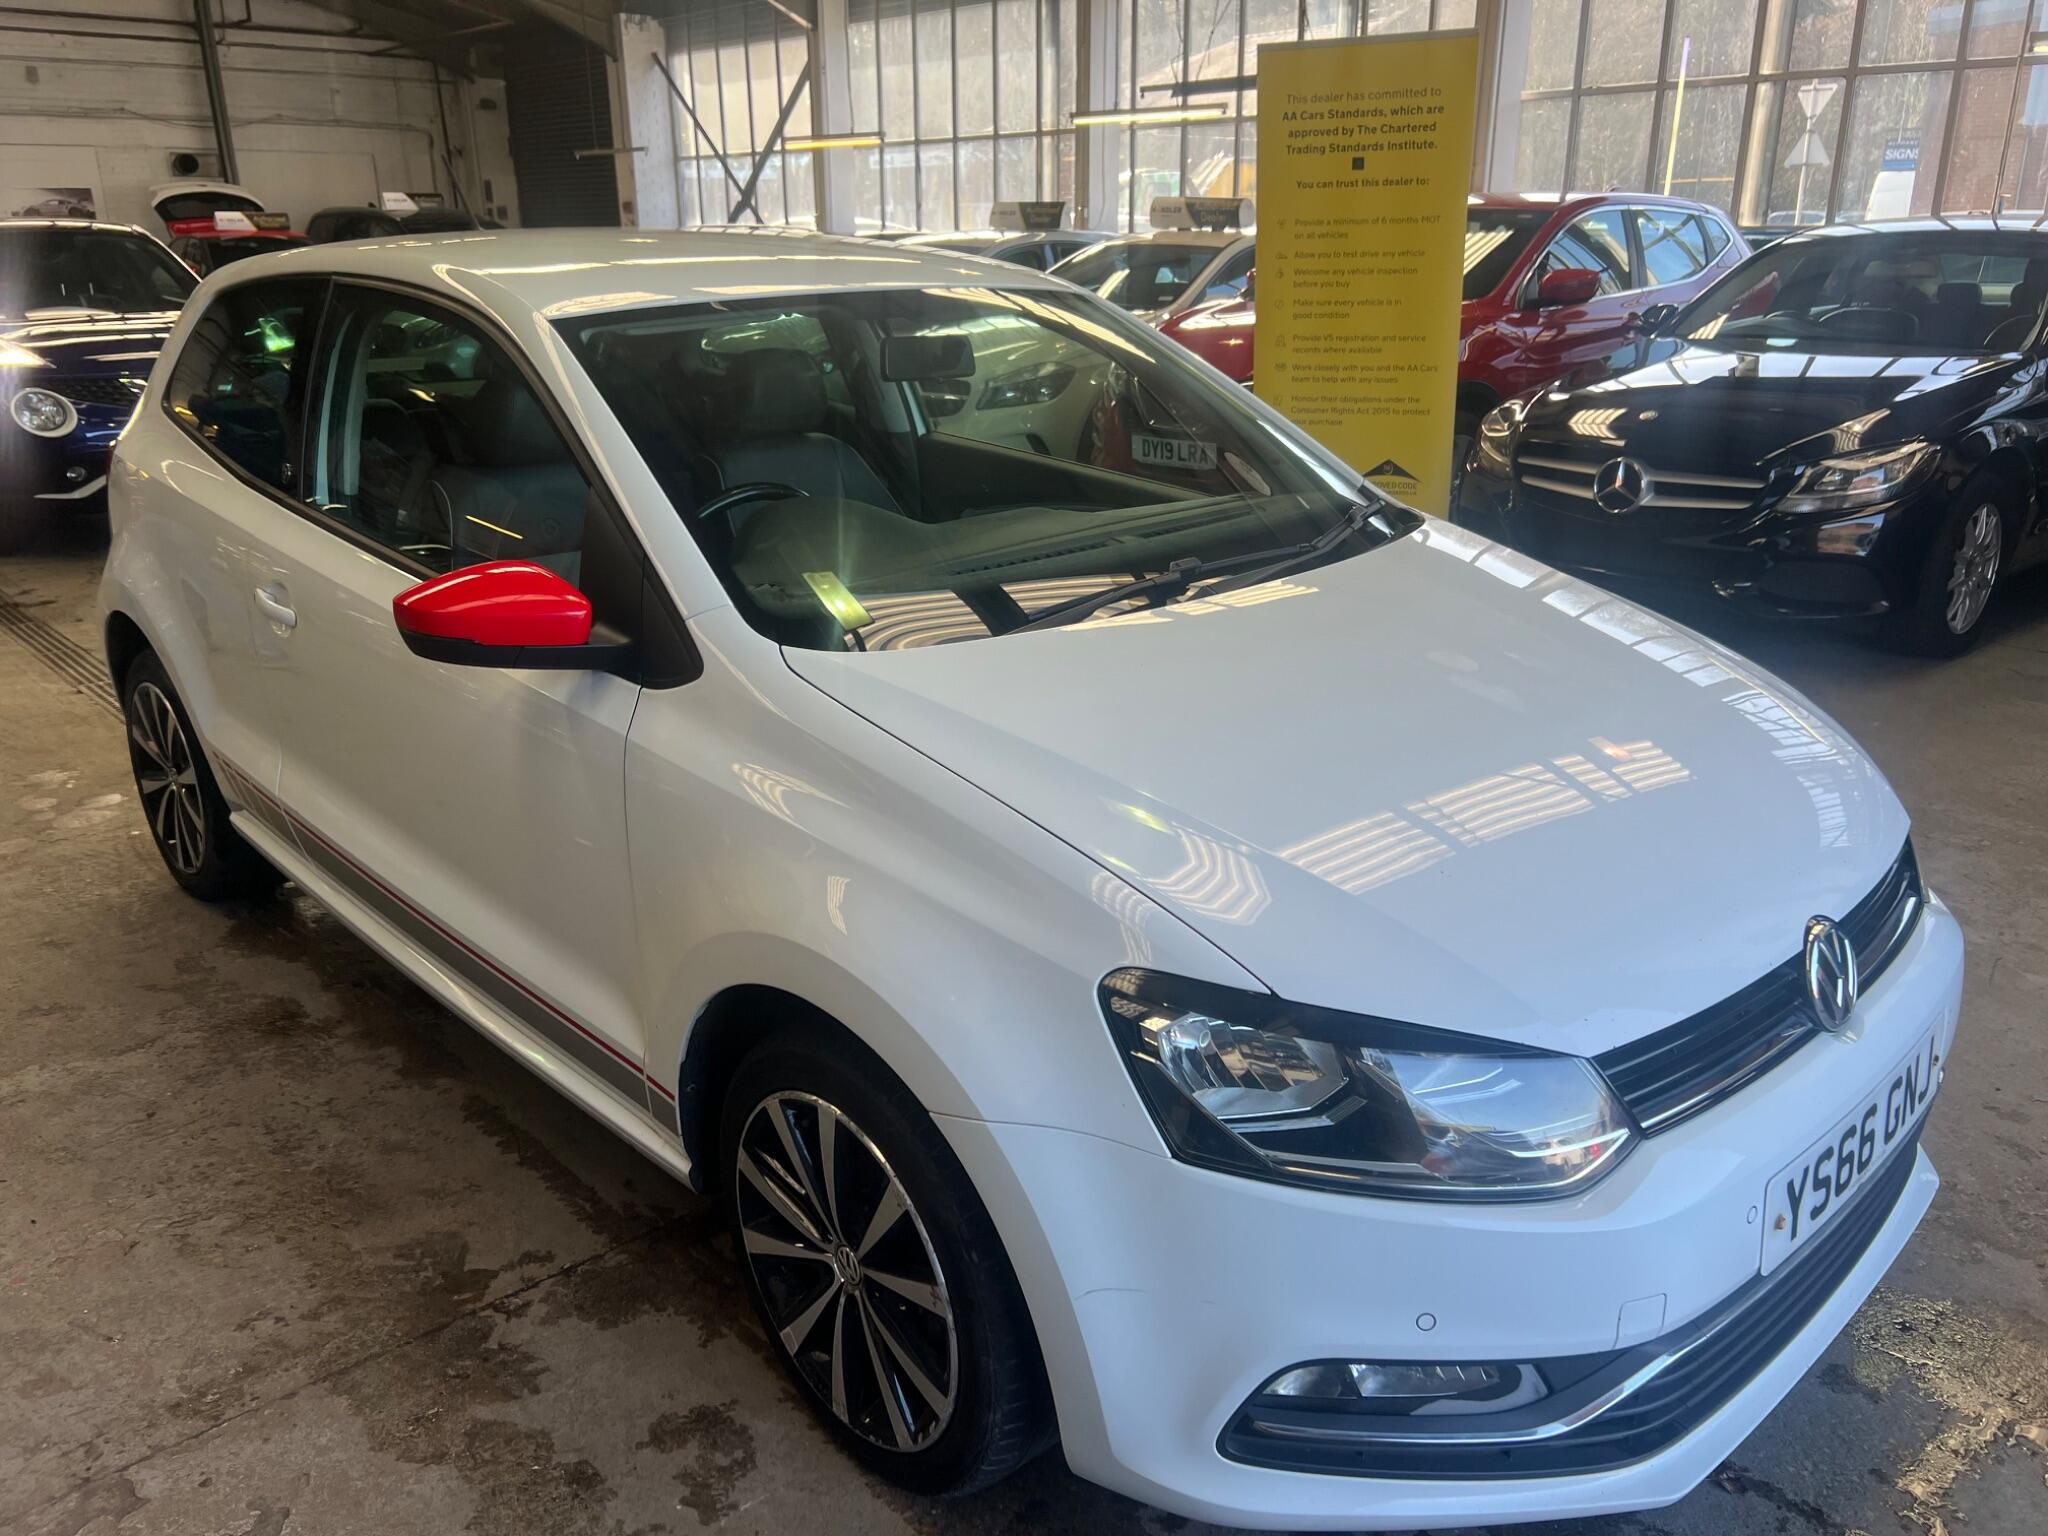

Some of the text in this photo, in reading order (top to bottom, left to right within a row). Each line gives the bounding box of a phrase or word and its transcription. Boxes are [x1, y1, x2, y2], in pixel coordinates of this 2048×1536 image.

[1287, 87, 1442, 105] This dealer has committed to
[1282, 105, 1444, 121] AA Cars Standards, which are
[1288, 122, 1437, 139] approved by The Chartered
[1286, 139, 1438, 155] Trading Standards Institute.
[1296, 180, 1313, 189] You
[1336, 179, 1359, 188] trust
[1362, 179, 1380, 187] this
[1382, 178, 1413, 186] dealer
[1416, 177, 1430, 185] to:
[1294, 218, 1325, 226] Provide
[1333, 217, 1370, 225] minimum
[1371, 217, 1380, 225] of
[1389, 216, 1419, 224] months
[1421, 215, 1441, 224] MOT
[1306, 231, 1316, 239] all
[1318, 231, 1349, 239] vehicles
[1294, 251, 1316, 259] Allow
[1318, 252, 1332, 260] you
[1343, 250, 1358, 258] test
[1360, 250, 1379, 258] drive
[1382, 251, 1395, 259] any
[1294, 267, 1418, 277] Welcome any vehicle inspection
[1293, 280, 1350, 289] before you buy
[1293, 298, 1314, 306] Make
[1293, 311, 1350, 320] good condition
[1336, 335, 1379, 343] registration
[1293, 346, 1382, 354] records where available
[1314, 365, 1340, 373] closely
[1360, 365, 1374, 373] you
[1420, 365, 1438, 373] Cars
[1313, 376, 1320, 384] to
[1321, 376, 1339, 385] help
[1340, 376, 1357, 384] with
[1321, 395, 1338, 403] their
[1384, 395, 1406, 403] under
[1291, 407, 1329, 415] Consumer
[1331, 407, 1354, 416] Rights
[1357, 407, 1370, 415] Act
[1402, 408, 1430, 416] protect
[1142, 438, 1208, 464] DY19 LRA
[1398, 481, 1418, 490] CODE
[1786, 1035, 1935, 1242] YS66 GNJ
